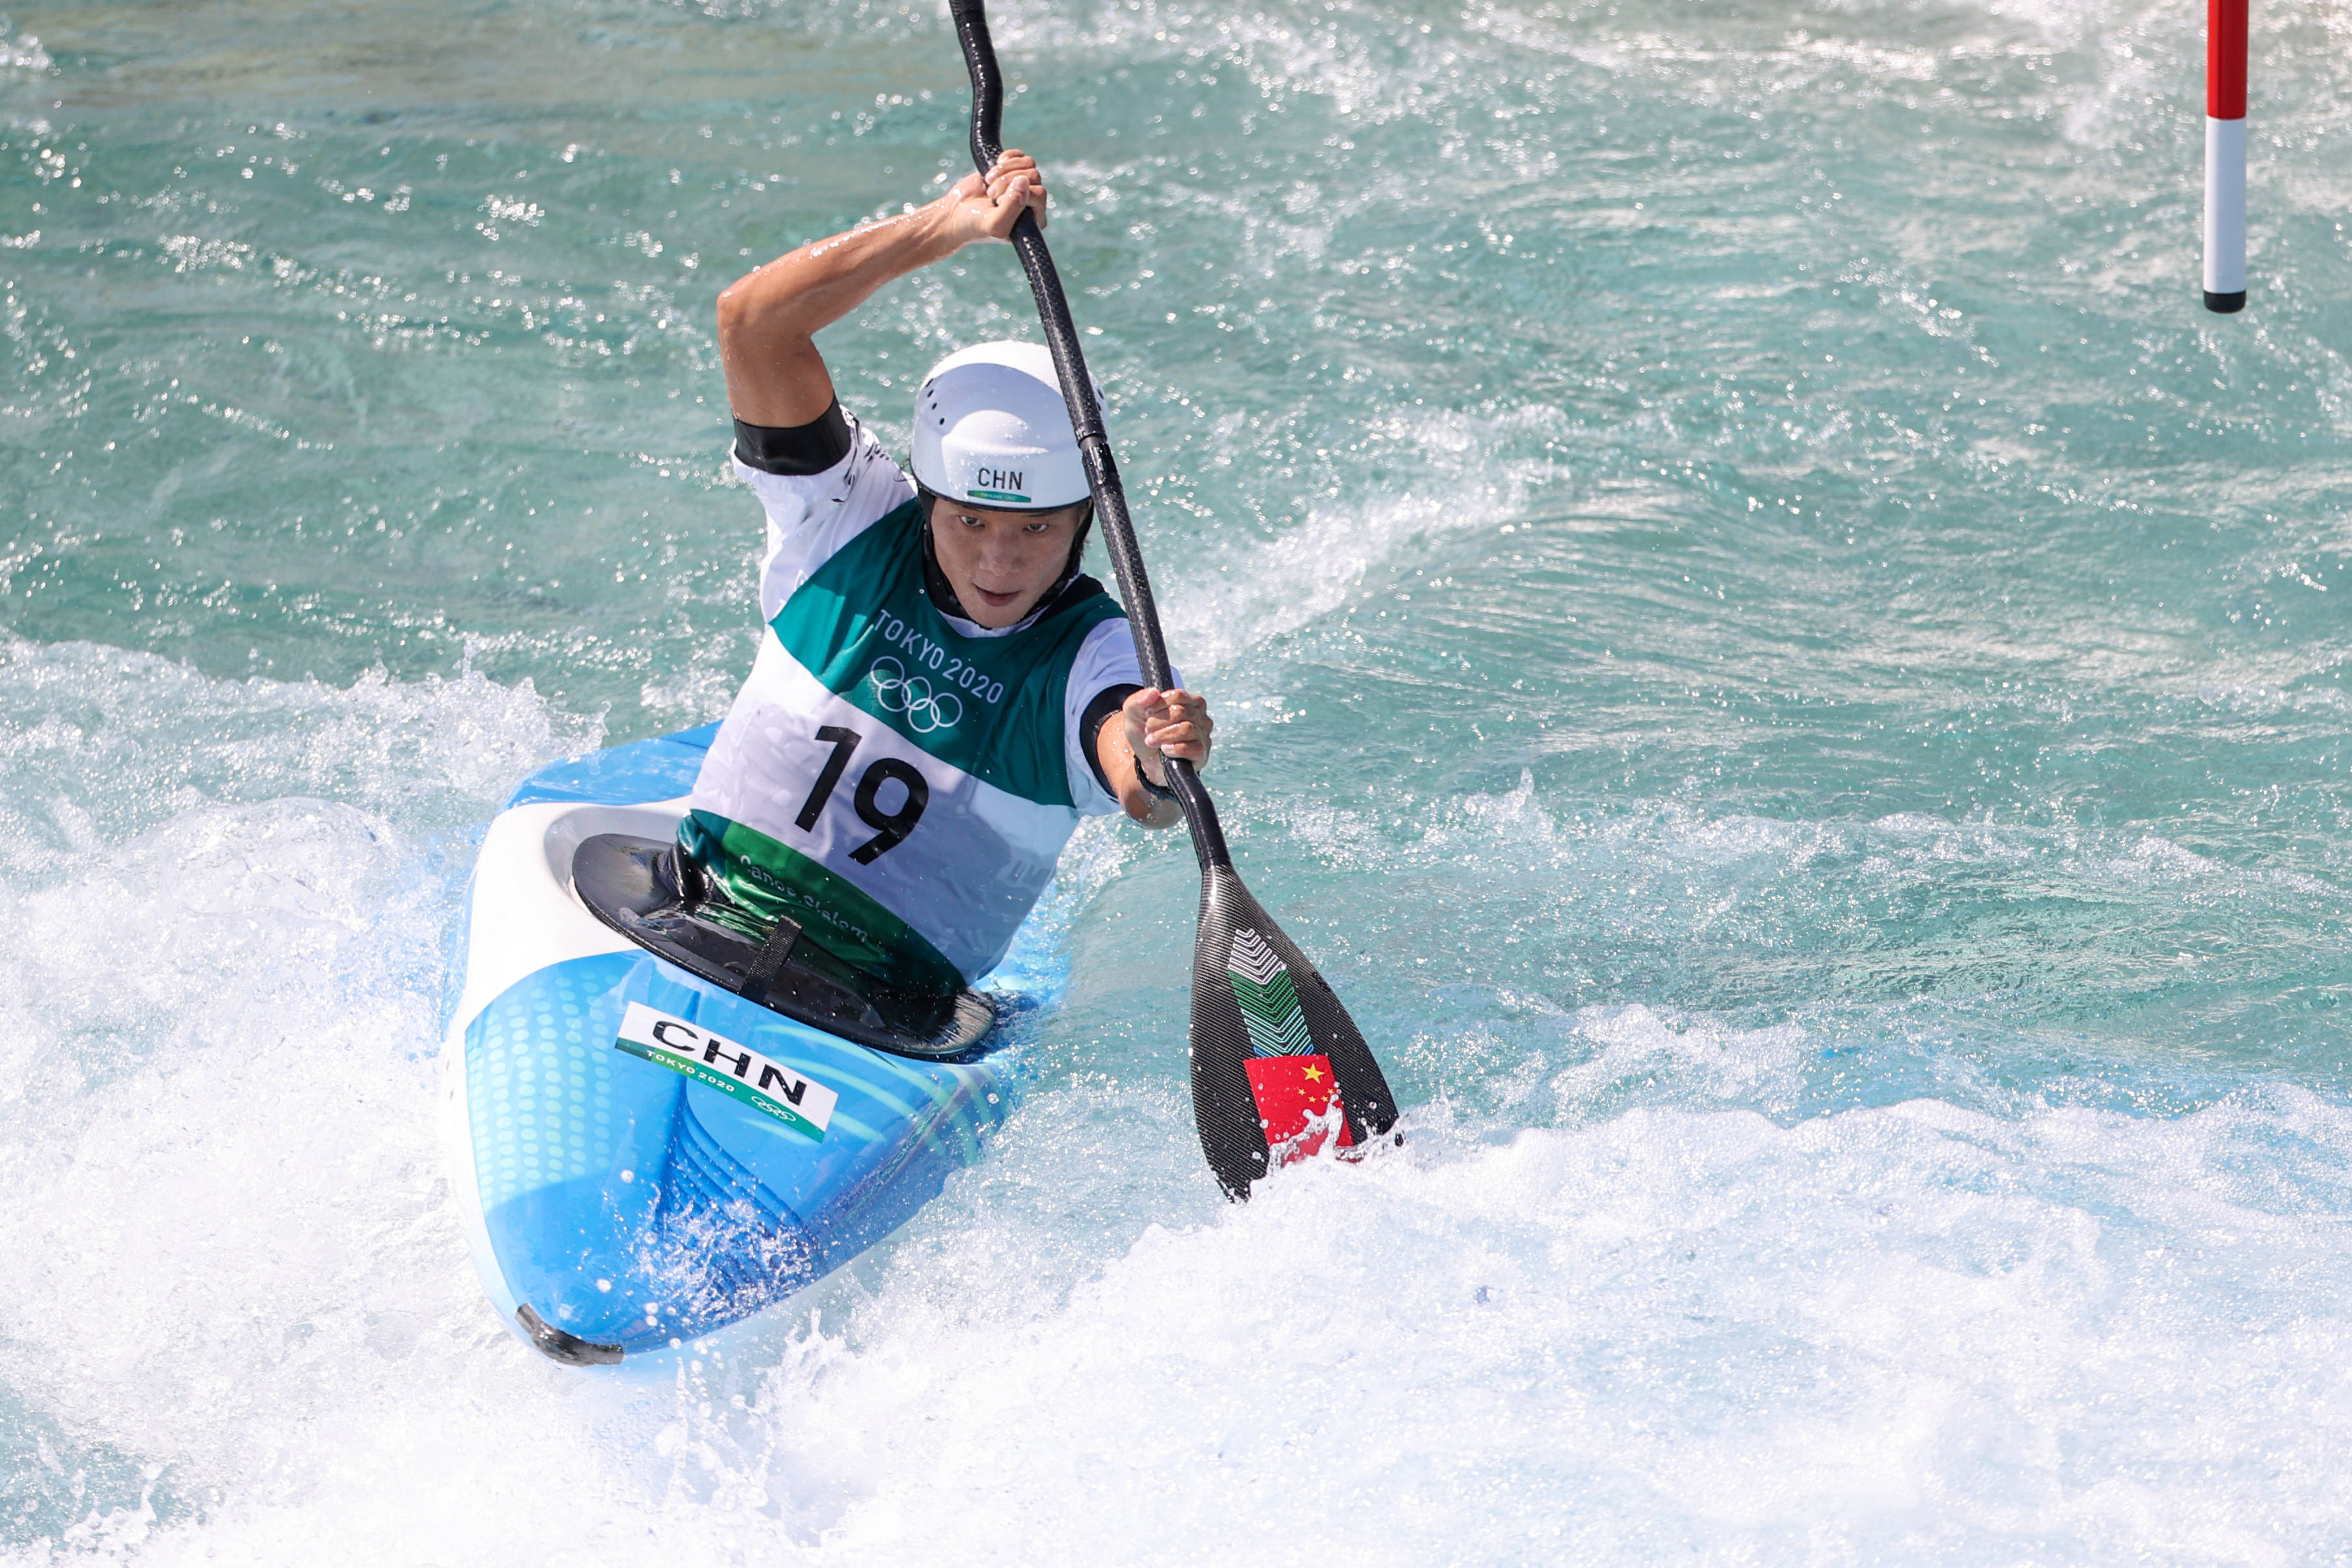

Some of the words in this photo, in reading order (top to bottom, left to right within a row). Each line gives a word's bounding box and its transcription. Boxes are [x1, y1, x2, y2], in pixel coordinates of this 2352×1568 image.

[978, 468, 1022, 490] CHN
[874, 609, 944, 670] TOKYO
[942, 658, 1004, 704] 2020
[795, 725, 929, 866] 19
[646, 1049, 697, 1074] TOKYO
[697, 1071, 735, 1093] 2020
[652, 1020, 807, 1106] CHN
